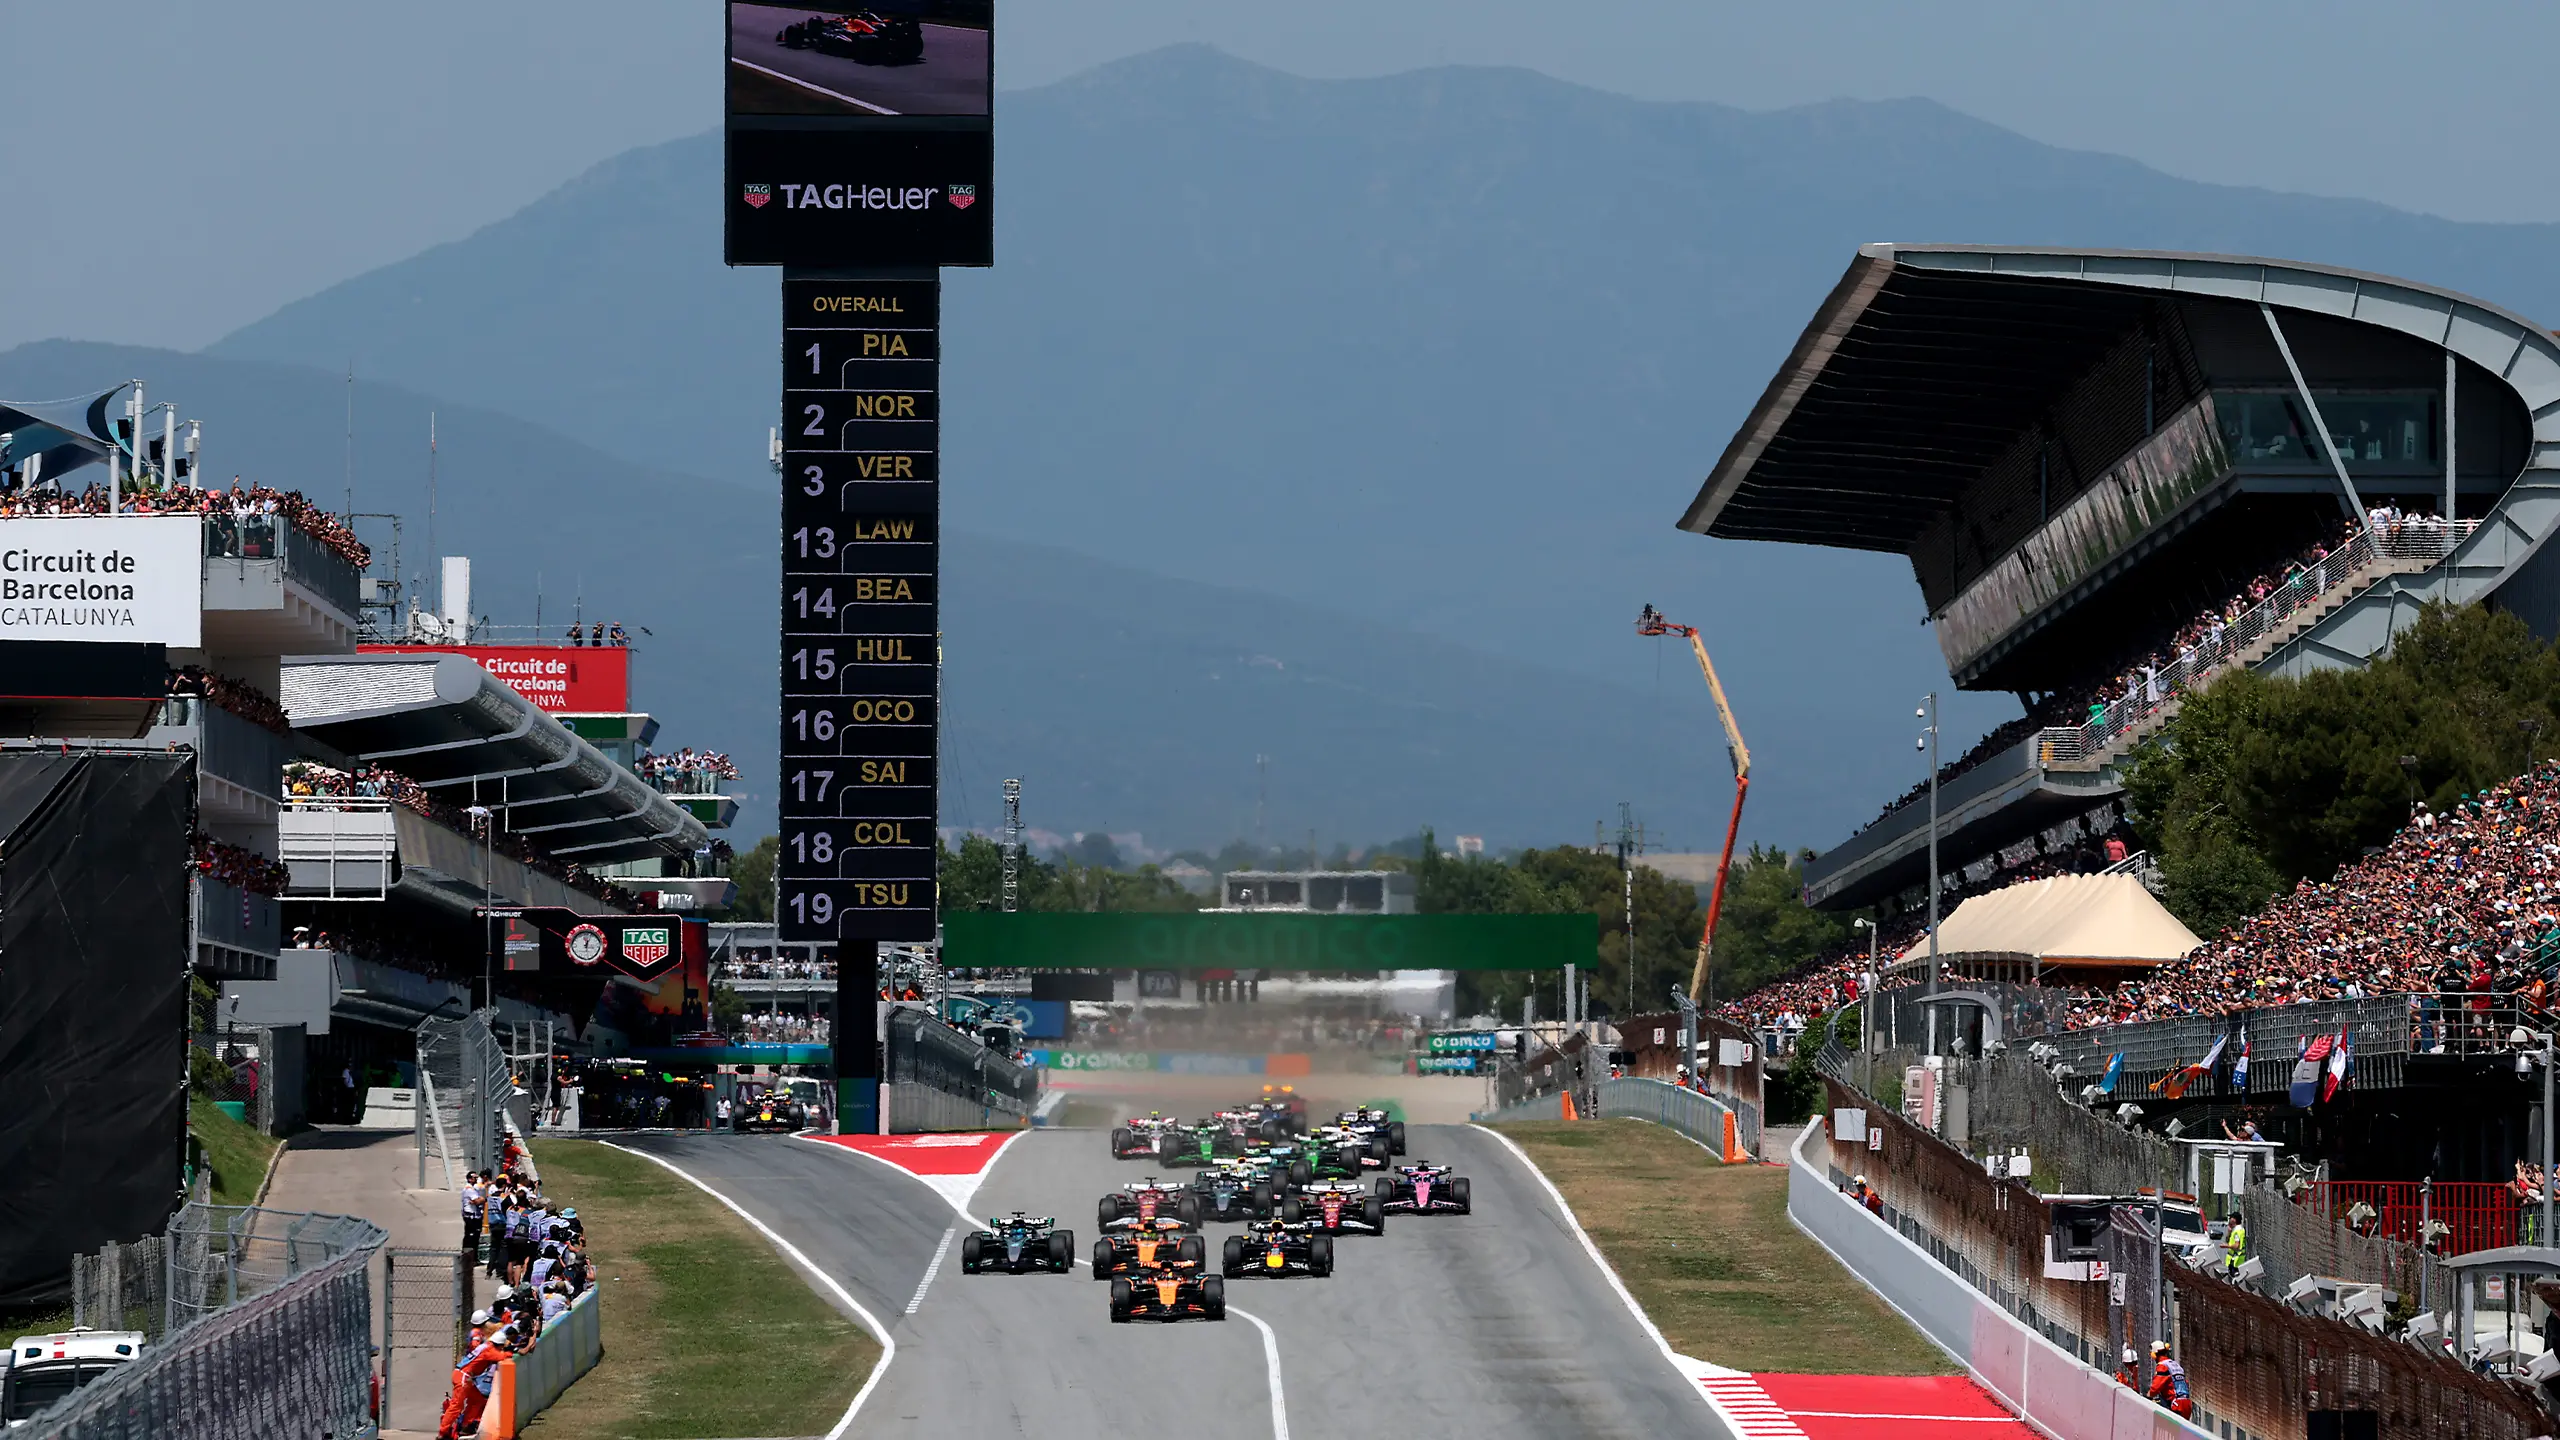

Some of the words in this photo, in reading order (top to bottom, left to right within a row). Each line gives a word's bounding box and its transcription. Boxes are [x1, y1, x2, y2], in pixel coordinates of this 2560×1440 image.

[746, 185, 768, 194] TAG
[951, 186, 972, 195] TAG
[812, 296, 904, 313] OVERALL
[804, 342, 821, 375] 1
[863, 333, 909, 356] PIA
[803, 404, 825, 436] 2
[855, 395, 916, 418] NOR
[803, 465, 825, 497] 3
[856, 456, 914, 478] VER
[793, 526, 836, 559] 13
[855, 519, 915, 540] LAW
[2, 548, 95, 573] Circuit
[102, 549, 135, 574] de
[3, 578, 134, 601] Barcelona
[792, 586, 836, 620] 14
[856, 578, 914, 601] BEA
[1, 607, 135, 627] CATALUNYA
[486, 658, 544, 675] Circuit
[546, 658, 567, 675] de
[791, 648, 836, 681] 15
[856, 639, 913, 662] HUL
[500, 676, 567, 692] rcelona
[791, 709, 836, 742] 16
[852, 700, 915, 722] OCO
[791, 769, 835, 803] 17
[860, 760, 906, 783] SAI
[790, 831, 834, 864] 18
[853, 822, 912, 845] COL
[789, 892, 834, 925] 19
[854, 883, 909, 906] TSU
[626, 931, 665, 944] TAG
[625, 946, 667, 966] HEUER
[1432, 1036, 1491, 1048] aramco
